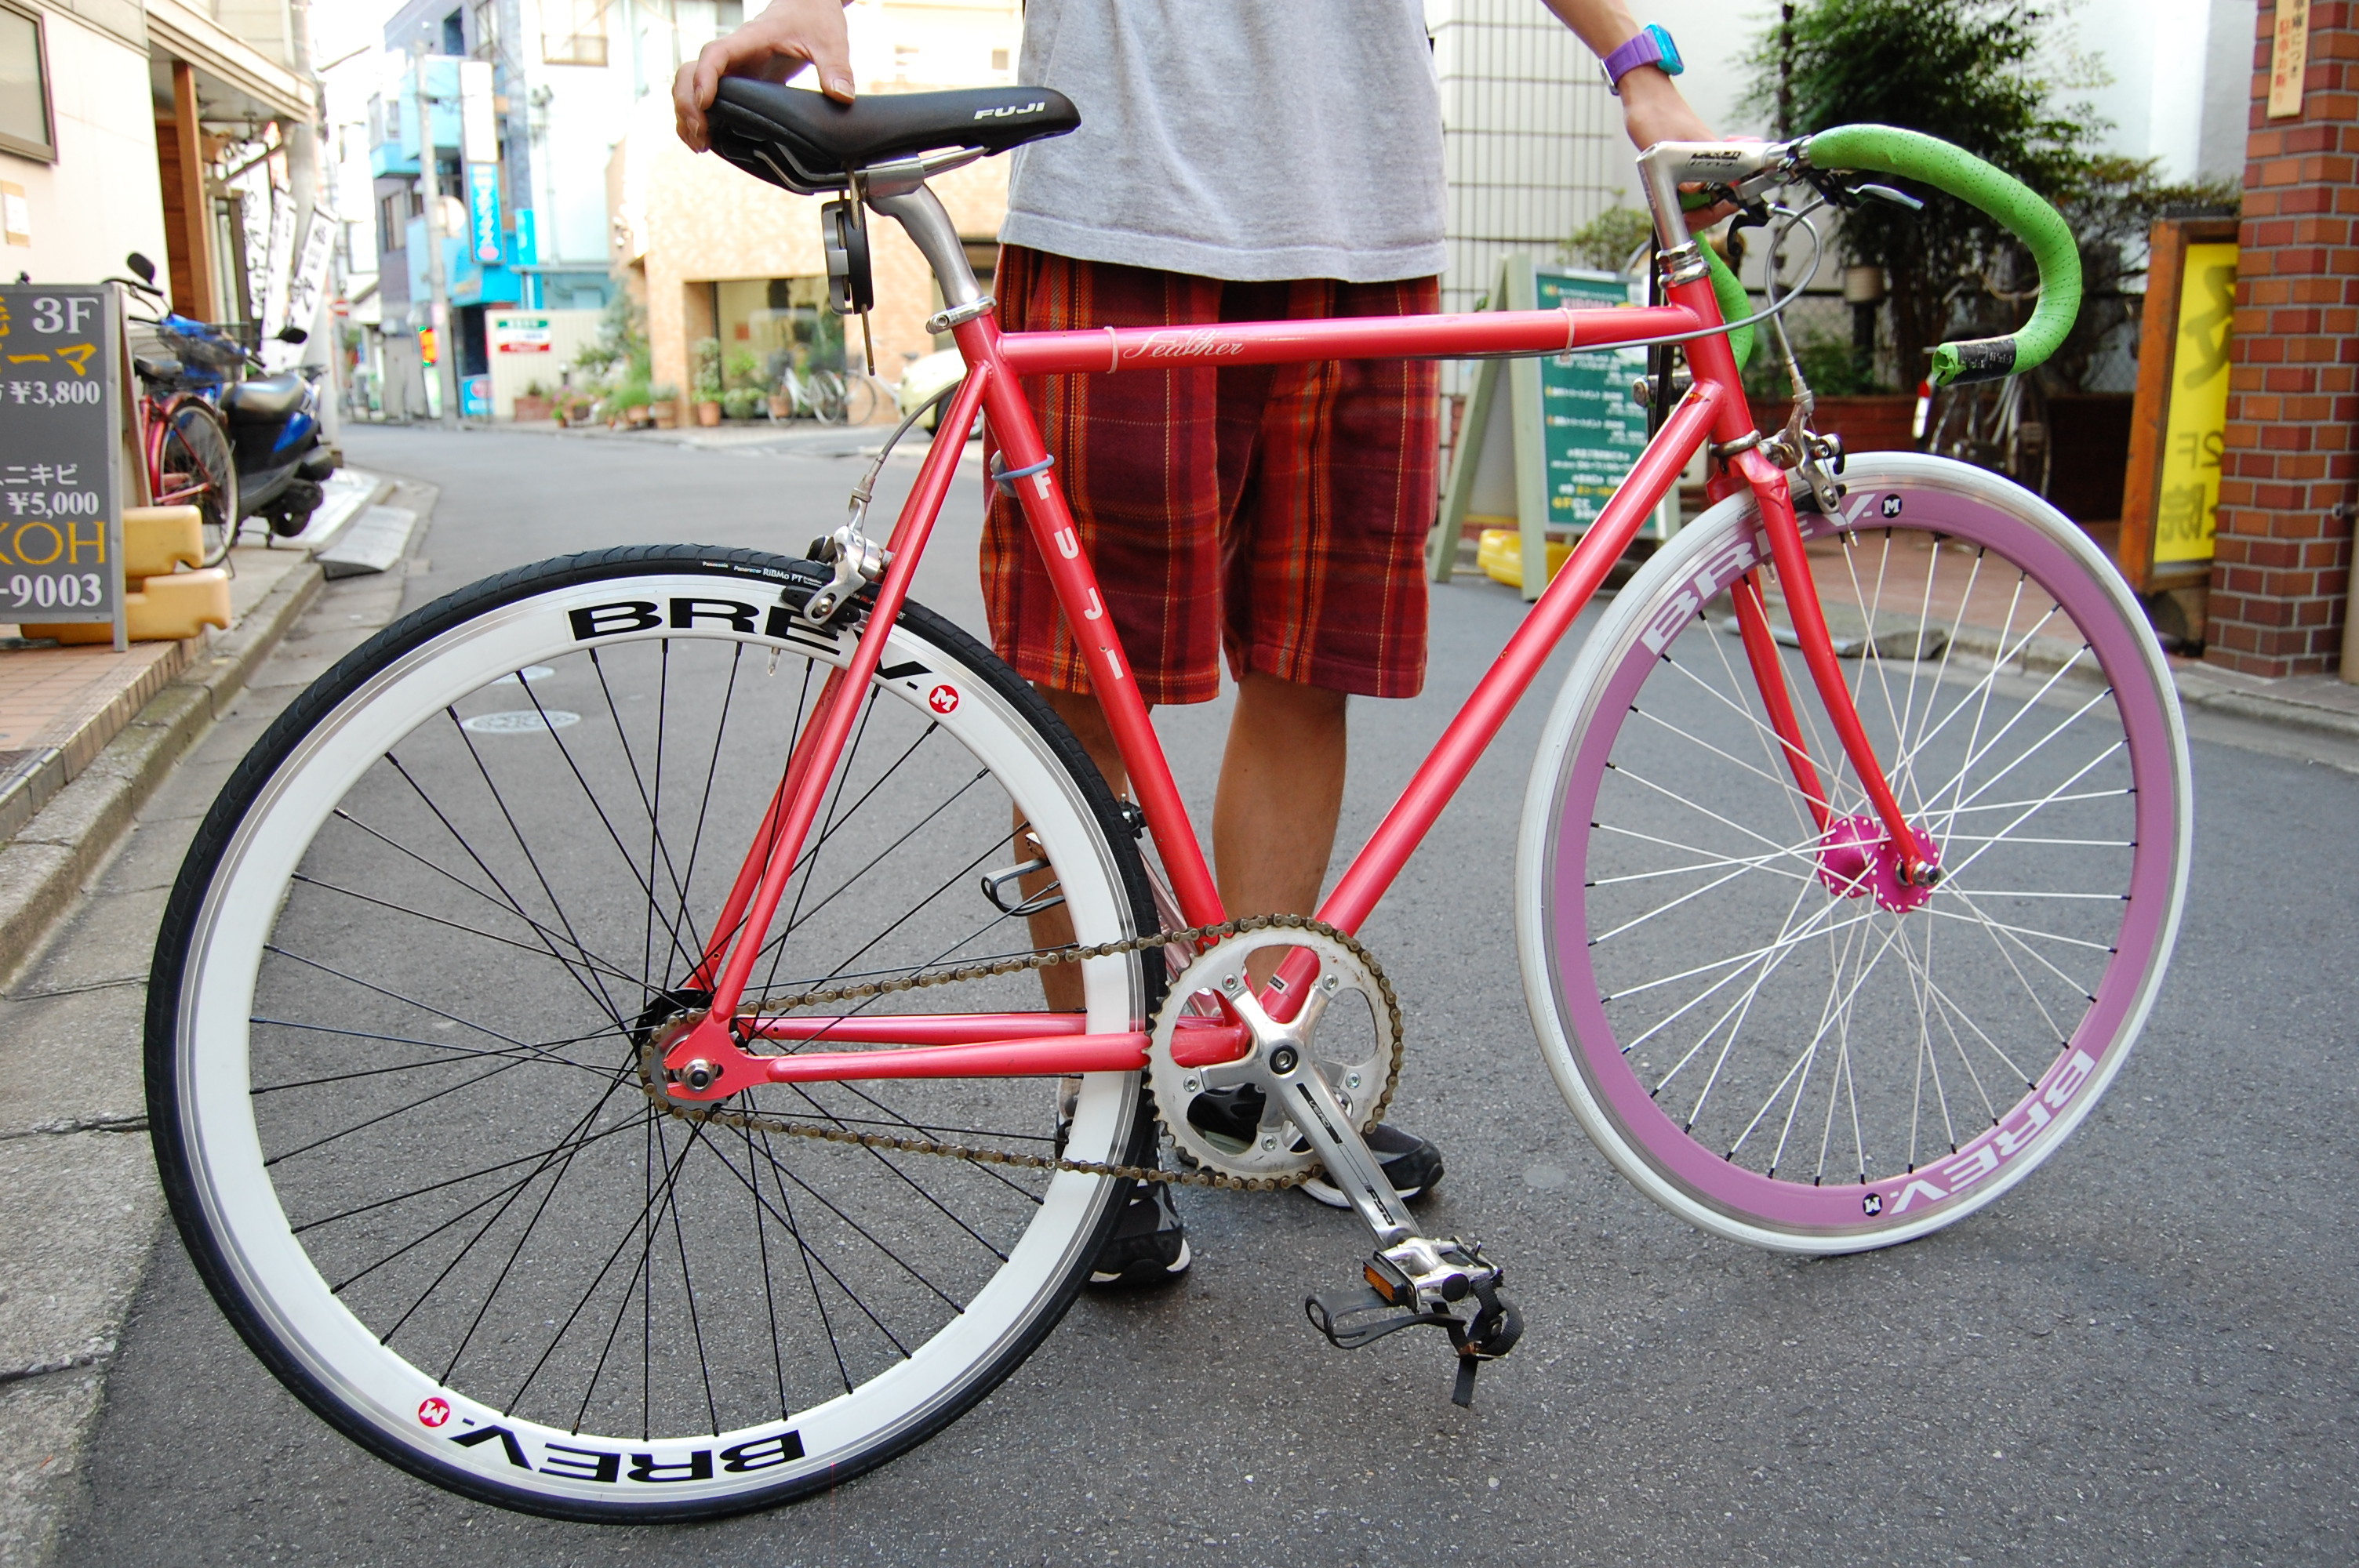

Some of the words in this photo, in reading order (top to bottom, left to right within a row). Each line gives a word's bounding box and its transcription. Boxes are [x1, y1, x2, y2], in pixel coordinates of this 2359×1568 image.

[974, 102, 1045, 120] FUJI
[32, 296, 99, 334] 3F
[1123, 328, 1245, 359] Feather
[0, 343, 97, 377] ーマ
[9, 380, 101, 408] ¥3,800
[6, 491, 100, 519] ¥5,000
[1031, 468, 1124, 680] FUJI
[0, 572, 102, 608] -9003
[1309, 1100, 1330, 1128] VERO
